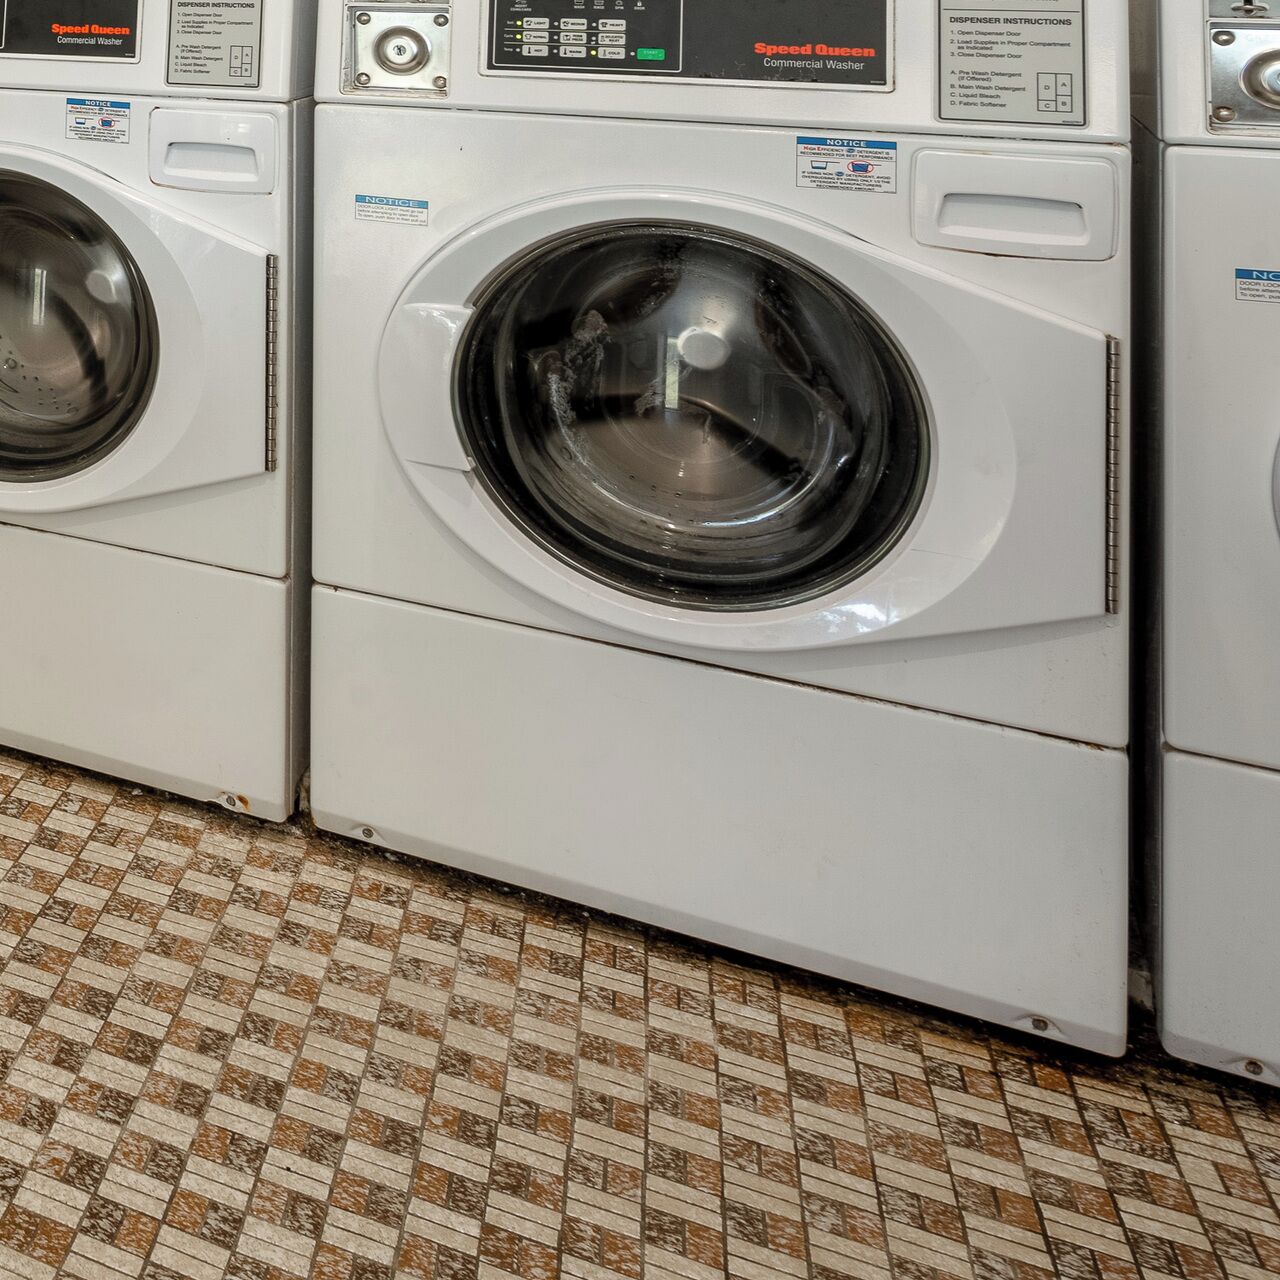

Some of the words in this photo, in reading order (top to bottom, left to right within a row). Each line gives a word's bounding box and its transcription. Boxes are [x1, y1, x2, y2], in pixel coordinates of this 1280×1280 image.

[52, 24, 89, 34] Speed
[91, 25, 129, 34] Queen
[57, 36, 96, 44] Commercial
[98, 37, 122, 45] Washer
[754, 43, 812, 55] Speed
[815, 44, 875, 56] Queen
[764, 58, 822, 68] Commercial
[826, 60, 864, 69] Washer
[366, 197, 418, 207] NOTICE
